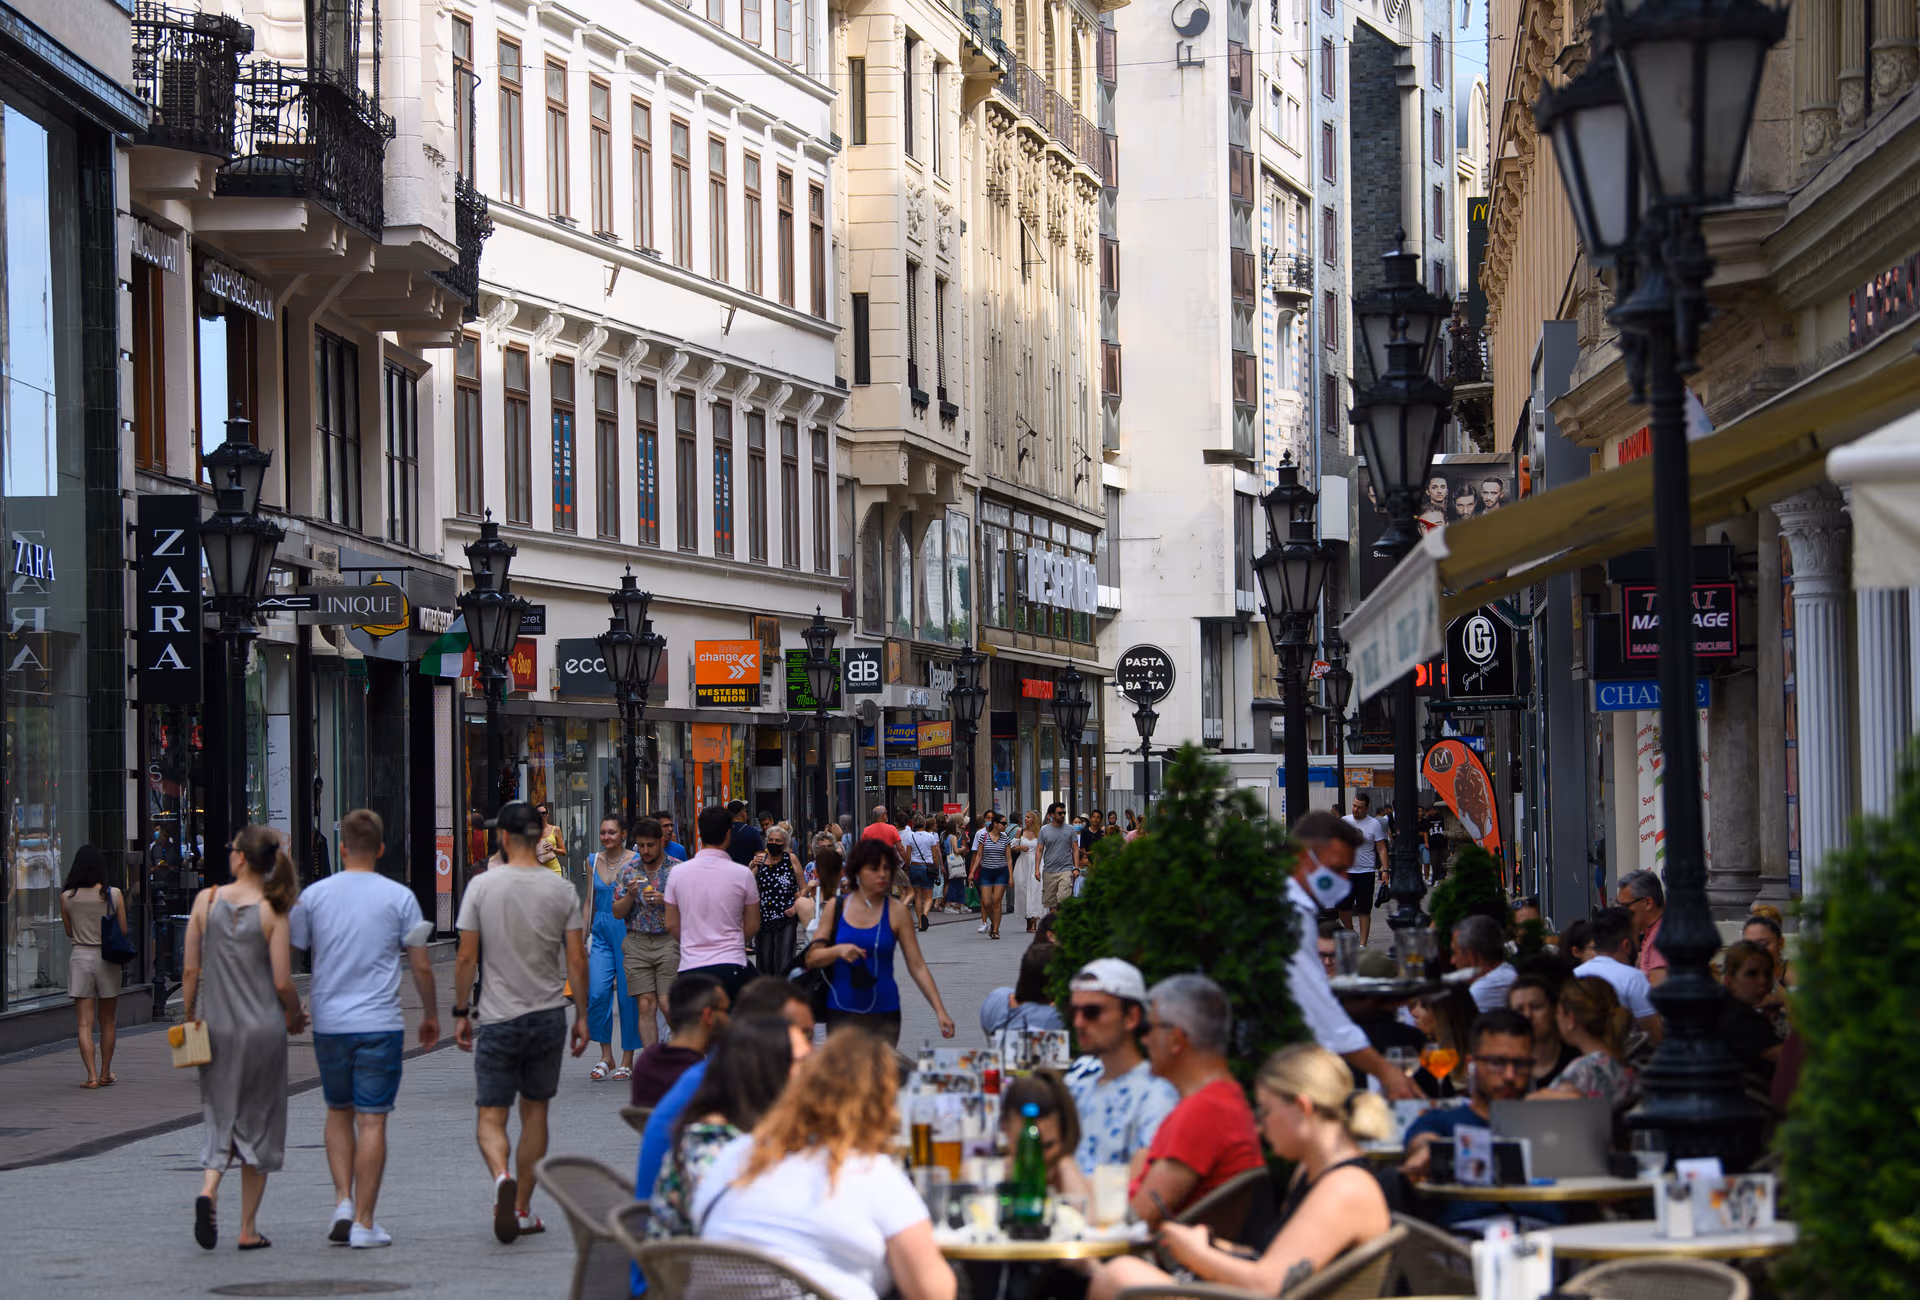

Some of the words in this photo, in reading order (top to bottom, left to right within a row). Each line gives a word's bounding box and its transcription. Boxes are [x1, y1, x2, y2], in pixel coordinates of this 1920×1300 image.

[13, 539, 56, 581] ZARA
[148, 529, 192, 670] ZARA
[318, 596, 396, 616] LINIQUE
[1632, 612, 1730, 630] MAAGE
[565, 657, 607, 674] ecc
[699, 652, 739, 664] change
[1125, 657, 1165, 667] PASTA
[848, 660, 879, 682] BB
[698, 688, 746, 697] WESTERN
[1125, 681, 1166, 691] BATA
[713, 695, 746, 703] UNION
[1600, 684, 1706, 706] CHANE
